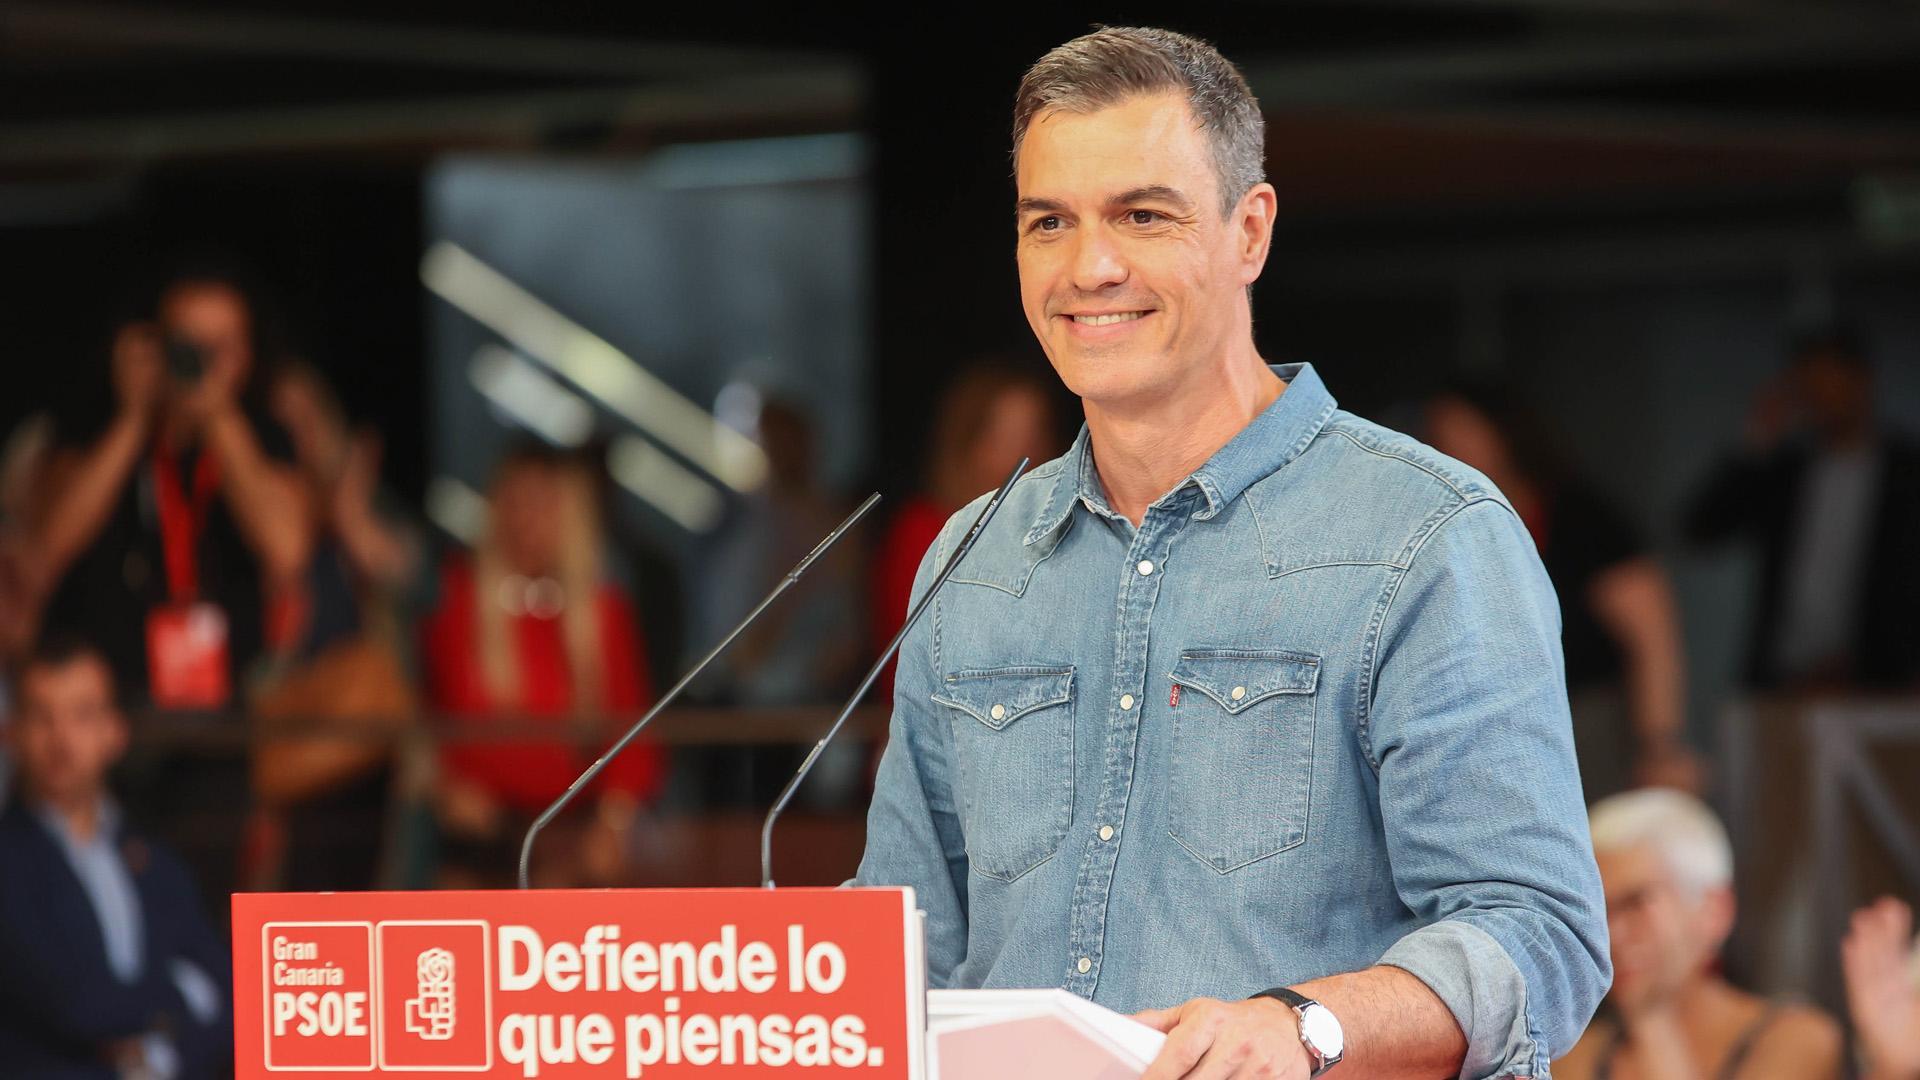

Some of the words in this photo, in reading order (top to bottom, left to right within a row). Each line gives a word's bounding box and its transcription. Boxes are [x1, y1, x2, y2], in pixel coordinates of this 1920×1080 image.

[273, 935, 318, 961] Gran
[498, 924, 778, 994] Defiende
[787, 924, 847, 994] lo
[273, 961, 344, 986] Canaria
[273, 991, 368, 1037] PSOE
[498, 1013, 615, 1078] que
[624, 997, 884, 1079] piensas.
